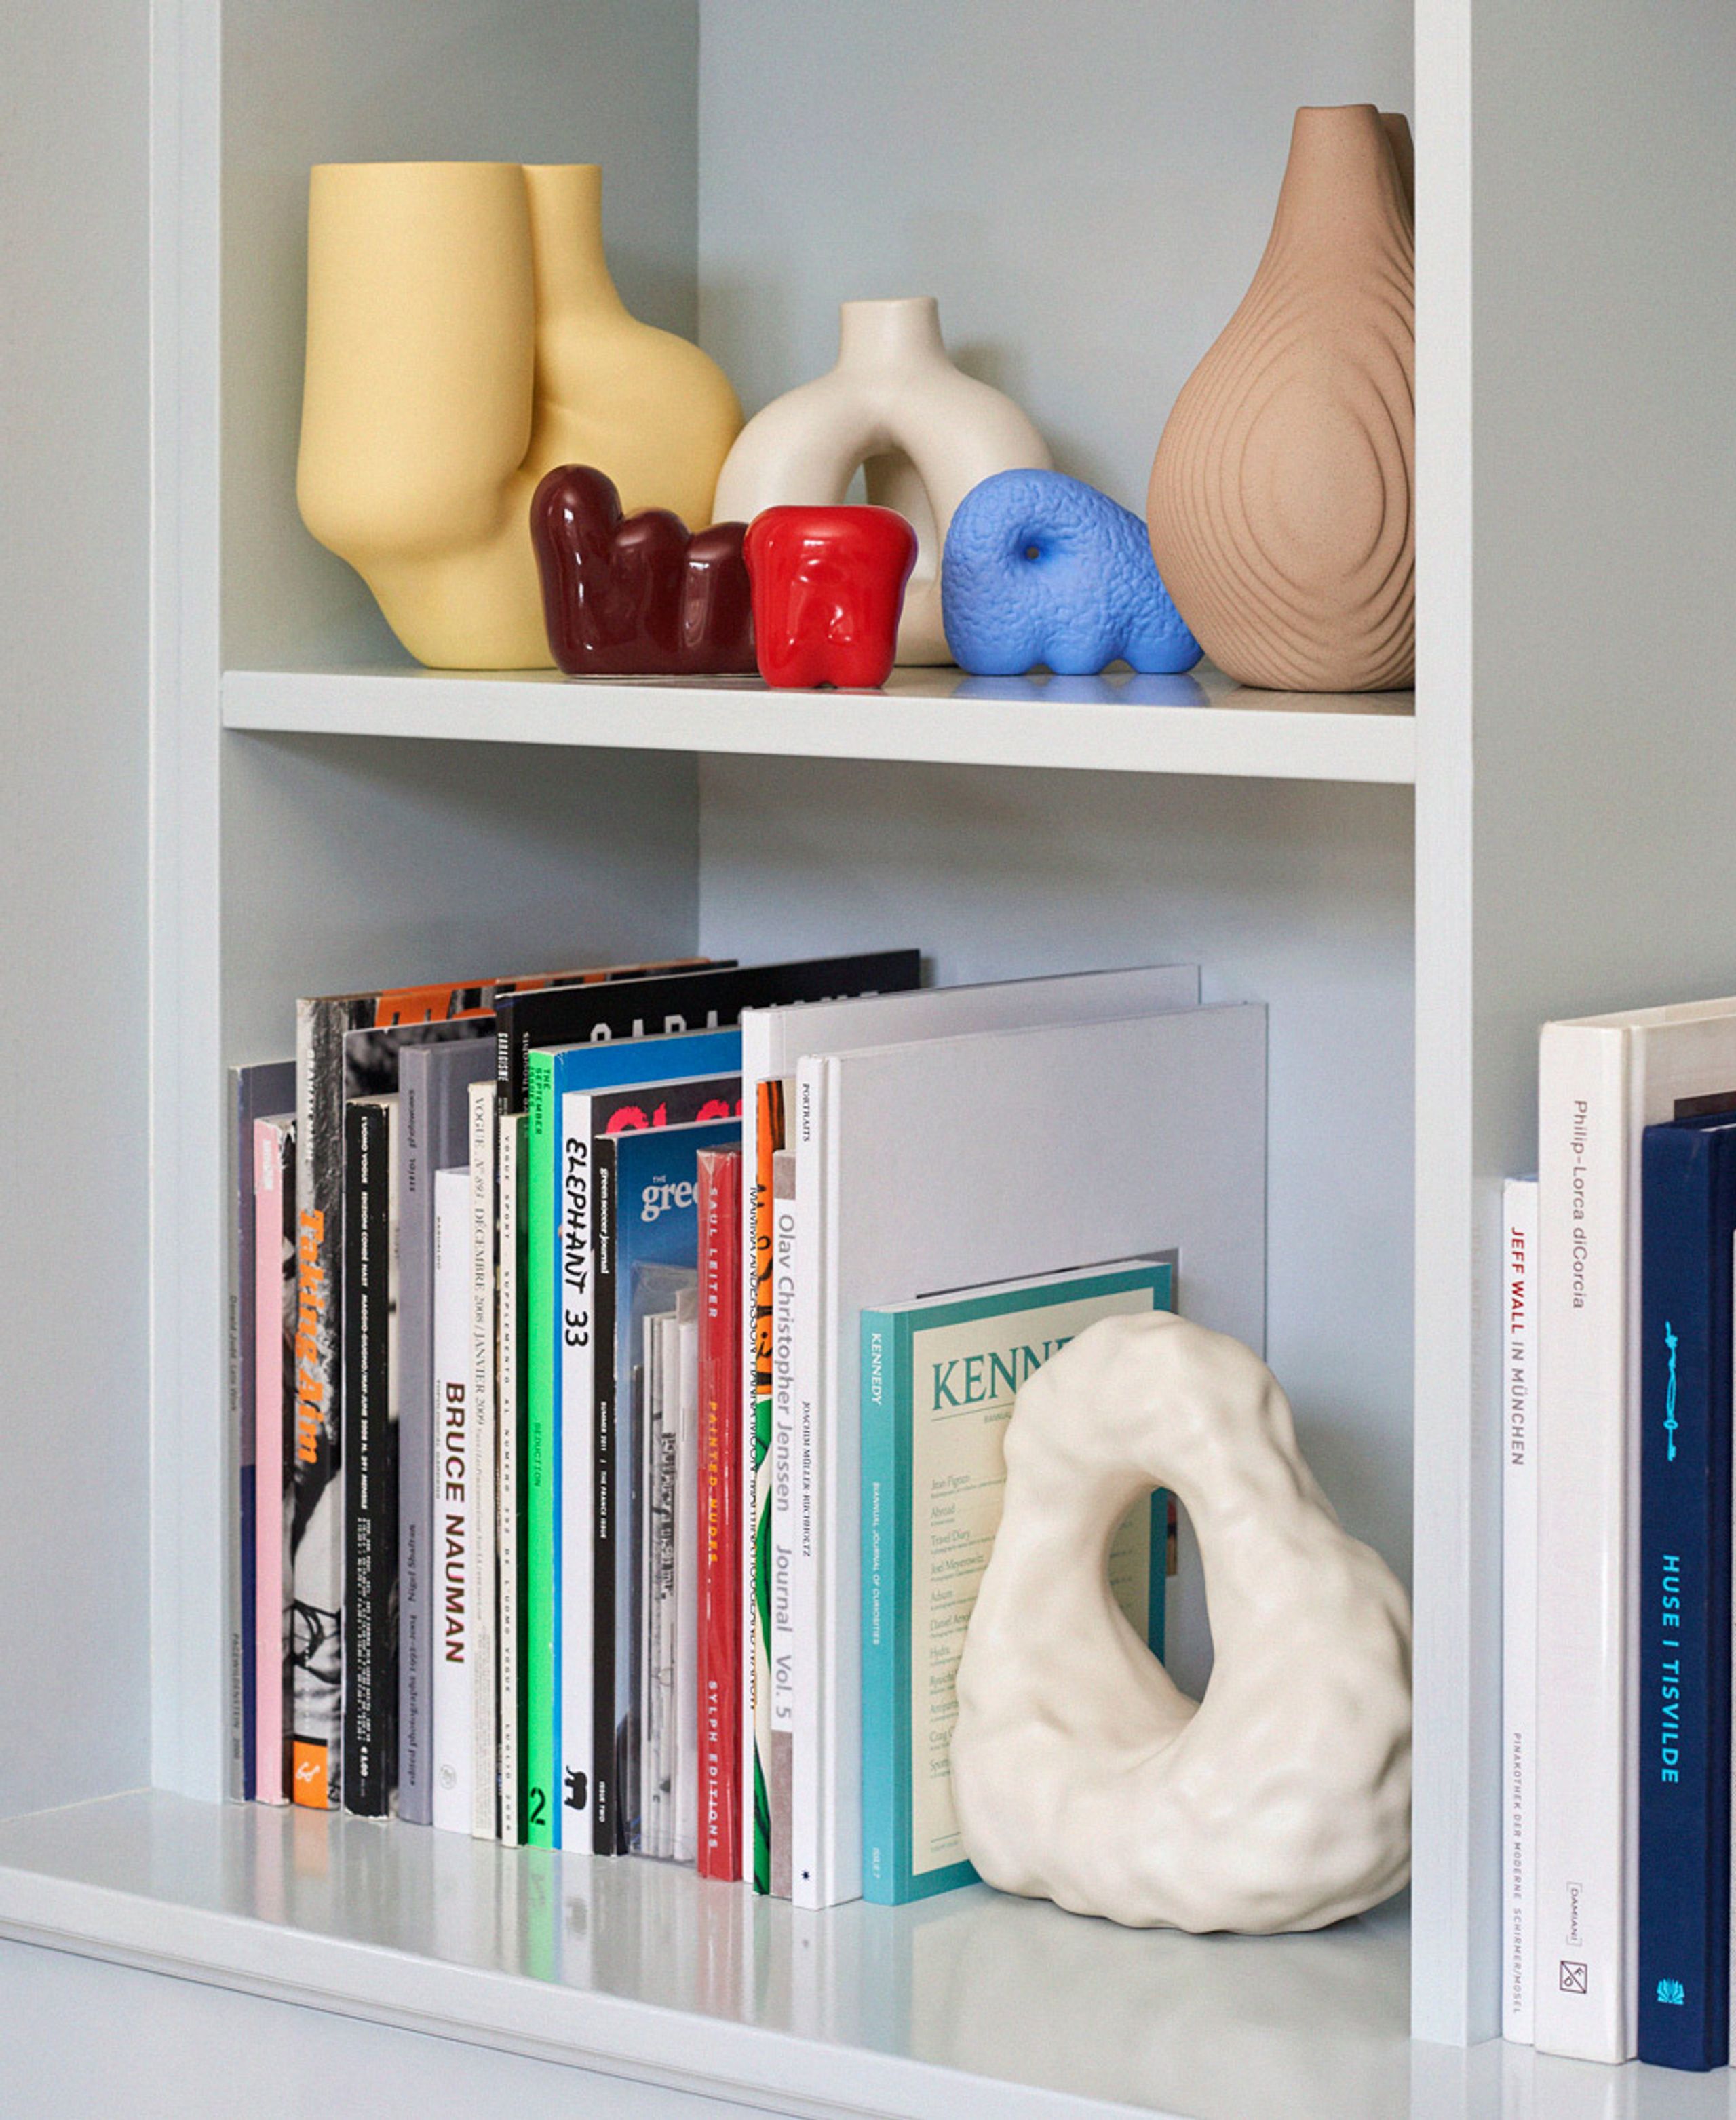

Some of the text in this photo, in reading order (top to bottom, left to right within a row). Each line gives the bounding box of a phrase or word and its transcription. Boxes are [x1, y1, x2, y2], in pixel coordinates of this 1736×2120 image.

[474, 1098, 484, 1148] VOGUE
[803, 1083, 811, 1142] PORTRAITS
[474, 1208, 486, 1291] DÉCEMBRE
[566, 1138, 588, 1347] ELEPHANT 33
[599, 1168, 609, 1273] green soccer journal
[708, 1187, 717, 1319] SAUL LEITER
[1570, 1100, 1588, 1309] Philip-Lorca diCorcia
[294, 1210, 324, 1463] Taking Aim
[475, 1294, 485, 1323] 2008
[1511, 1227, 1528, 1465] JEFF WALL IN MÜNCHEN
[474, 1331, 485, 1393] JANVIER
[476, 1398, 485, 1425] 2009
[775, 1214, 794, 1511] Olav Christopher Jenssen
[872, 1333, 882, 1405] KENNEDY
[932, 1335, 1075, 1410] KENN
[446, 1383, 465, 1663] BRUCE NAUMAN
[709, 1401, 717, 1563] PAINTED NUDES
[775, 1545, 792, 1718] Journal Vol. 5
[872, 1574, 880, 1585] OF
[872, 1588, 880, 1644] CURIOSITIES
[1661, 1555, 1680, 1627] HUSE
[708, 1680, 718, 1849] SYLPH EDITIONS
[1661, 1659, 1680, 1784] TISVILDE
[530, 1787, 546, 1826] 2
[1513, 1733, 1522, 2013] PINAKOTHEK DER MODERNE SCHIRMER/MOSEL
